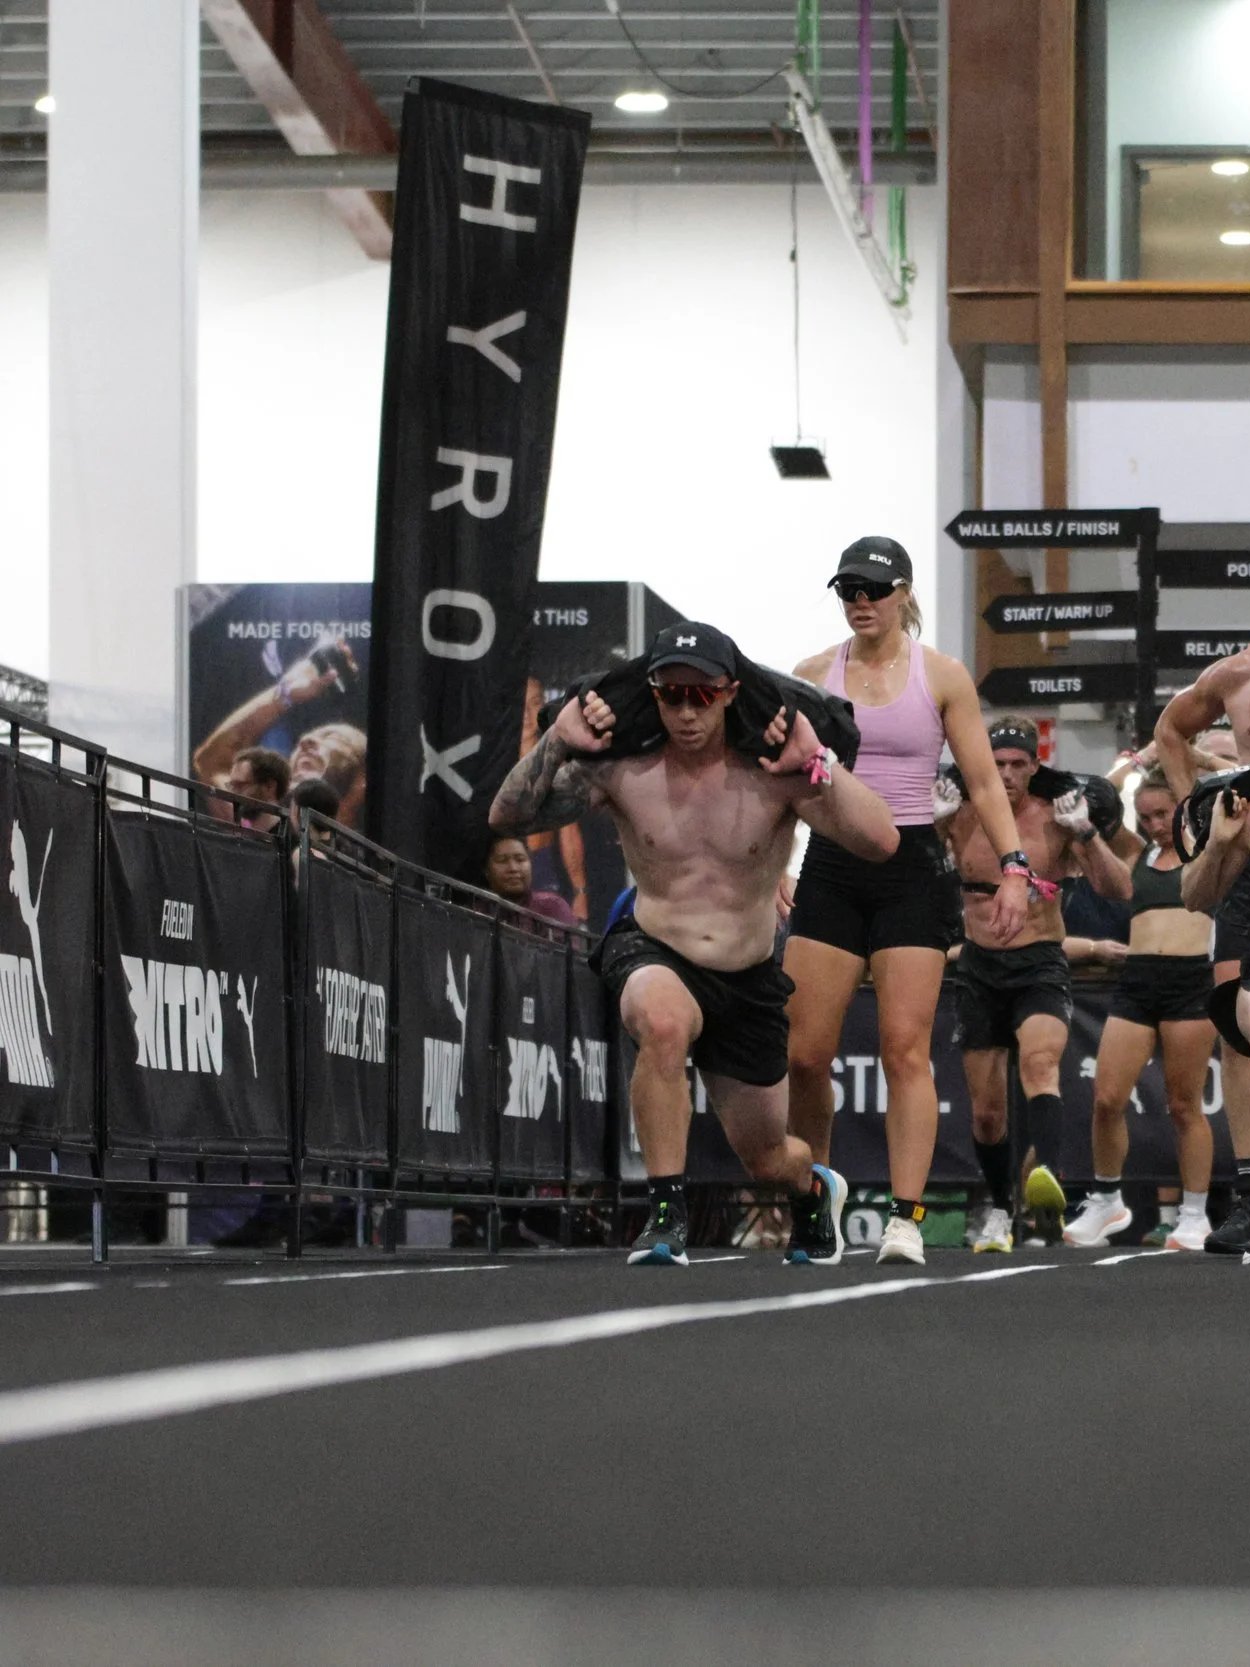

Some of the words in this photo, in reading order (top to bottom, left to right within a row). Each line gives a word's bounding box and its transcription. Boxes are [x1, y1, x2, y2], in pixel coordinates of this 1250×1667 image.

[419, 153, 543, 802] HYROX
[957, 522, 1001, 537] WALL
[1003, 521, 1053, 537] BALLS
[1067, 521, 1120, 536] FINISH
[545, 609, 589, 627] THIS
[1003, 607, 1042, 622] START
[1054, 605, 1092, 620] WARM
[1095, 604, 1114, 618] UP
[228, 621, 282, 640] MADE
[286, 621, 323, 639] FOR
[328, 620, 372, 639] THIS
[1185, 642, 1236, 656] RELAY
[1029, 678, 1082, 694] TOILETS
